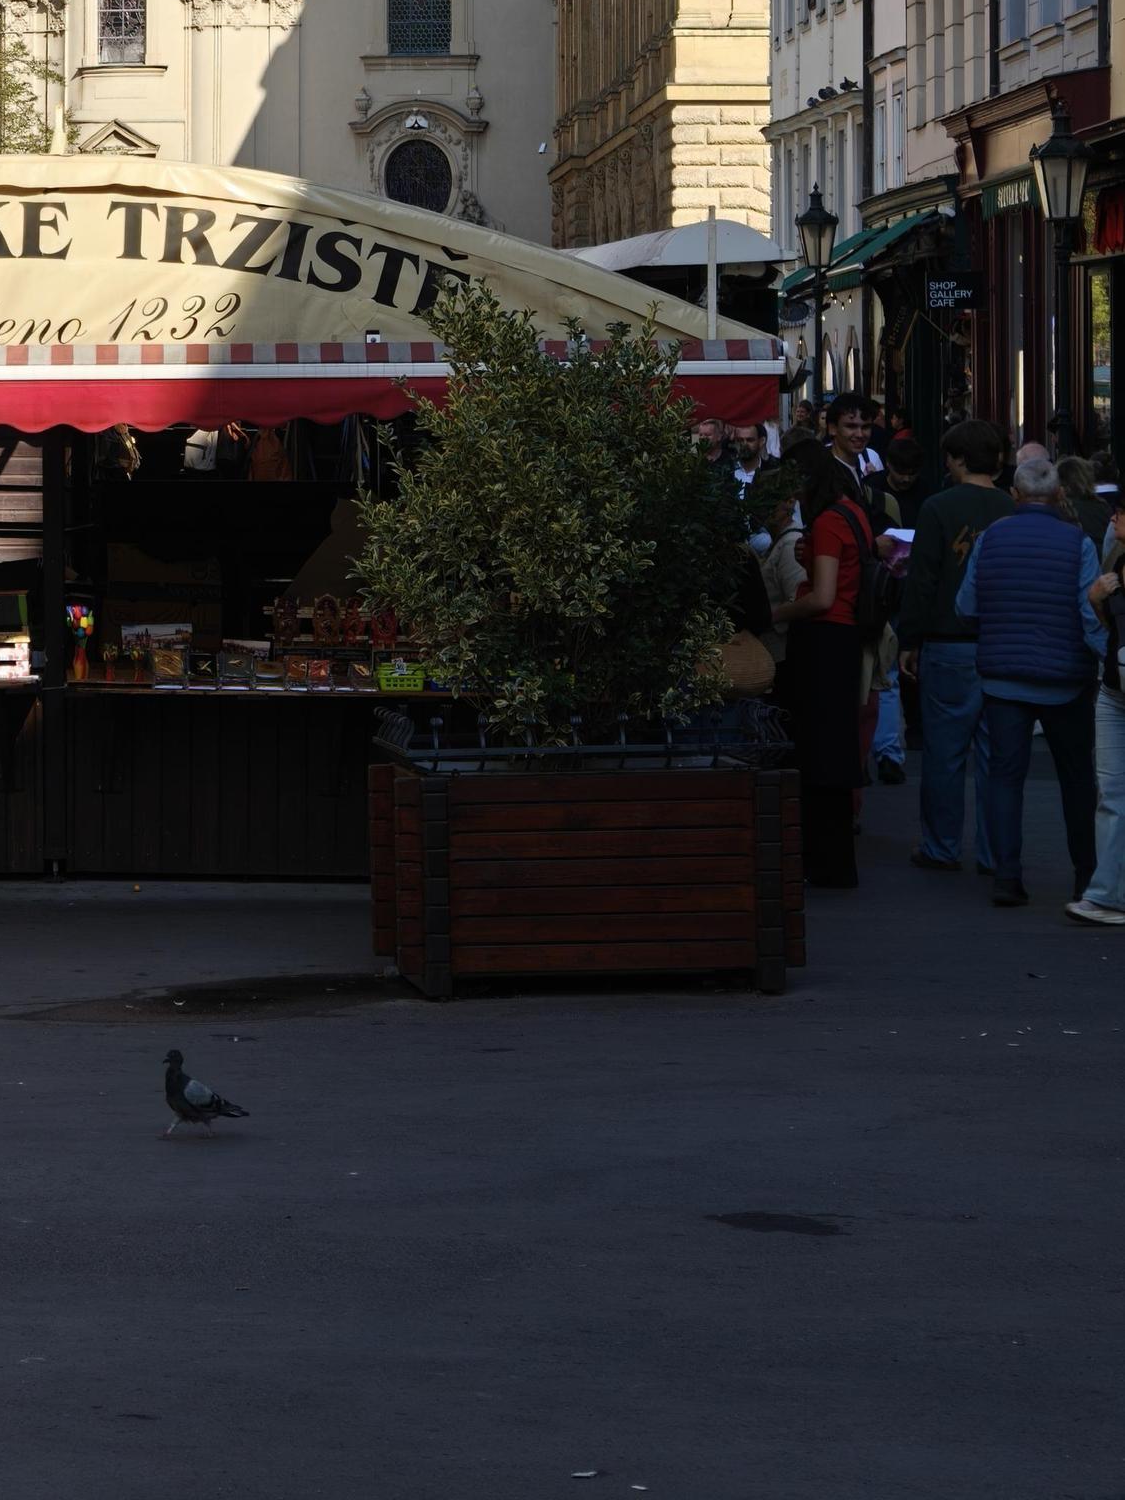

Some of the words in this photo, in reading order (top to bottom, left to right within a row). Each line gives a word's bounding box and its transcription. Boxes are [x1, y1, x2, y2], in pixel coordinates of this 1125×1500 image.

[929, 281, 957, 290] SHOP
[929, 290, 973, 299] GALLERY
[930, 299, 955, 307] CAFE
[108, 293, 242, 342] 1232
